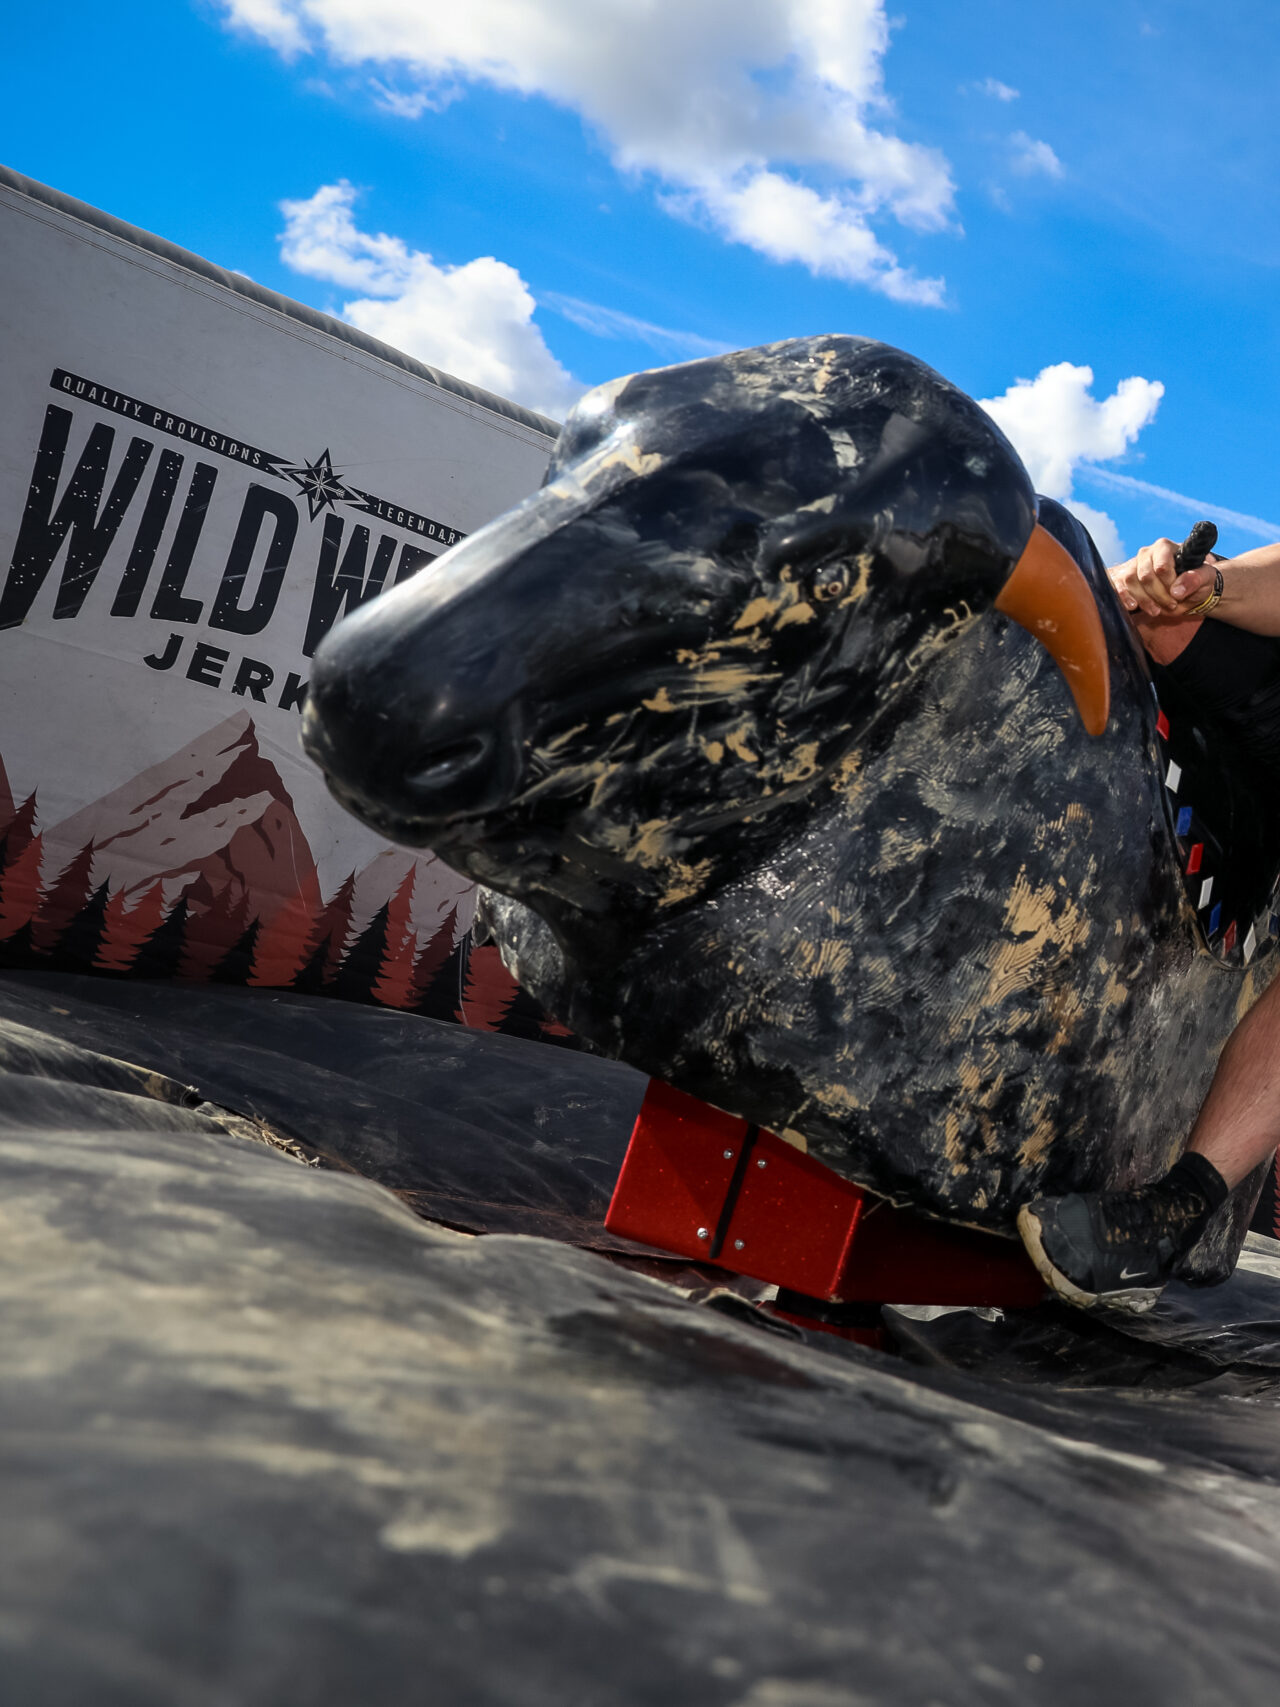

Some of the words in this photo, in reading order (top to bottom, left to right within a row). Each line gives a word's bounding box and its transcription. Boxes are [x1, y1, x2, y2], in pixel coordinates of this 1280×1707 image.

[62, 376, 142, 416] QUALITY
[153, 412, 261, 465] PROVISIONS
[0, 403, 299, 636] WILD
[143, 633, 309, 715] JERK
